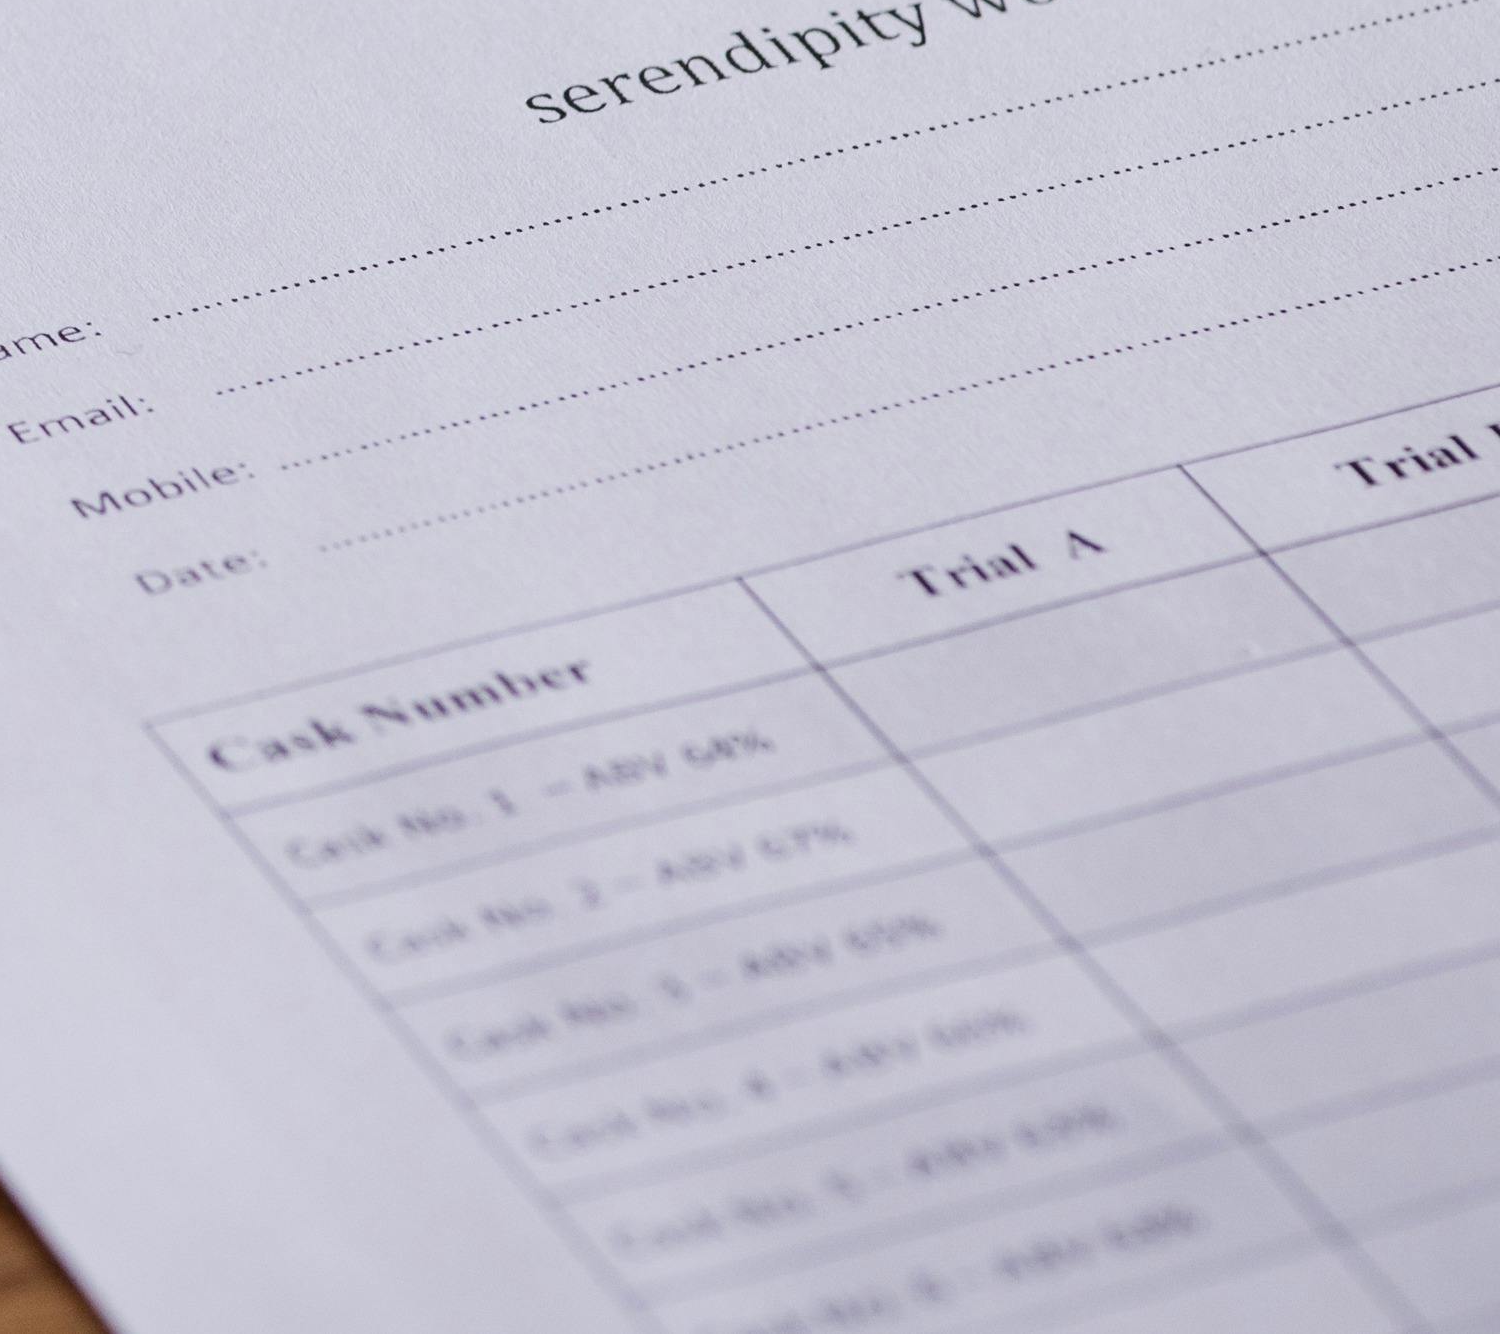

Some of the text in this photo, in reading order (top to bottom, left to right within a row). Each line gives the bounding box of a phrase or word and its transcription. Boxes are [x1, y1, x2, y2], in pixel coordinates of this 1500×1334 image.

[524, 0, 934, 125] serendipity
[8, 395, 155, 445] Email:
[1334, 435, 1480, 485] Trial
[71, 462, 255, 520] Mobile:
[135, 549, 269, 598] Date:
[898, 530, 1108, 597] Trial A
[209, 660, 592, 774] Cask Number
